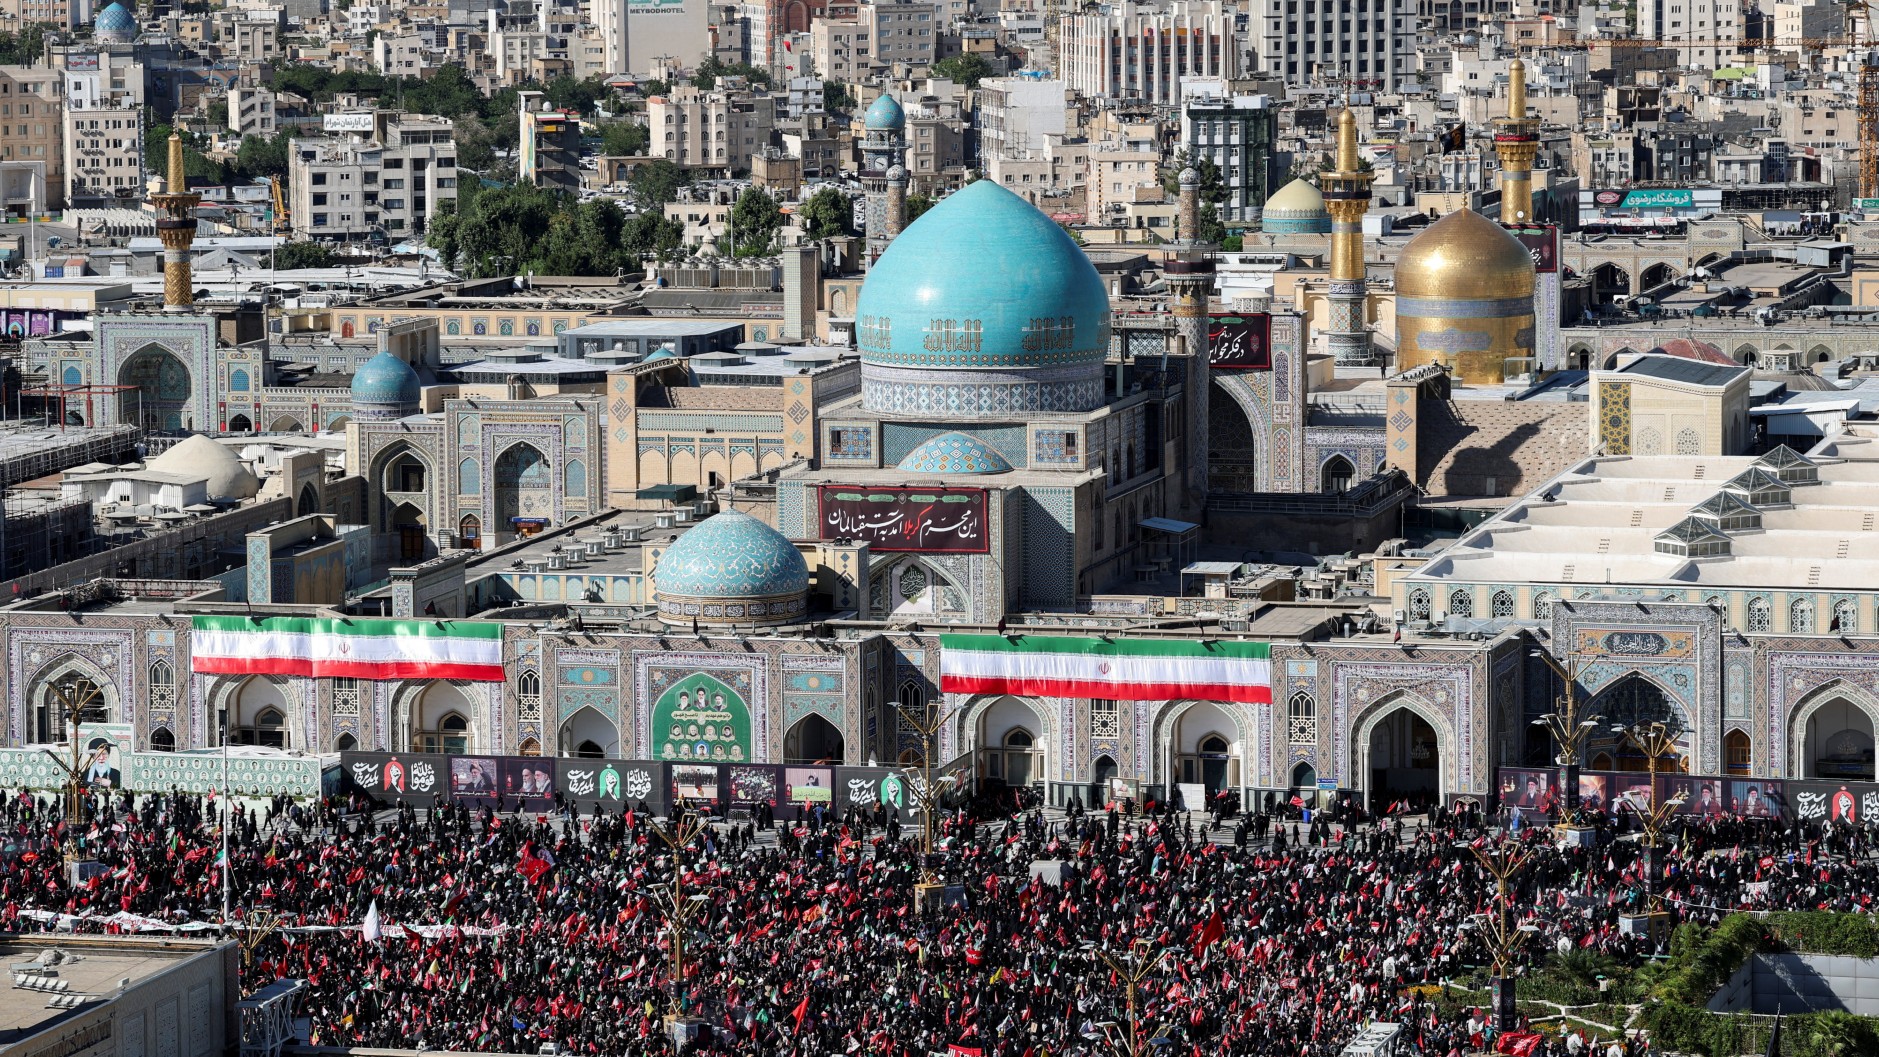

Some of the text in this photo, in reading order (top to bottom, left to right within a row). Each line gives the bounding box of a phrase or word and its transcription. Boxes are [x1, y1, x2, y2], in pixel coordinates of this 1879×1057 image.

[361, 117, 372, 128] هتل
[1627, 193, 1651, 205] رضوی
[1652, 192, 1689, 204] فروشگاه
[1217, 342, 1229, 360] محو
[1224, 330, 1248, 359] فکر
[1235, 349, 1245, 359] در
[904, 505, 934, 540] کربلا
[958, 517, 978, 538] این
[879, 525, 888, 541] به
